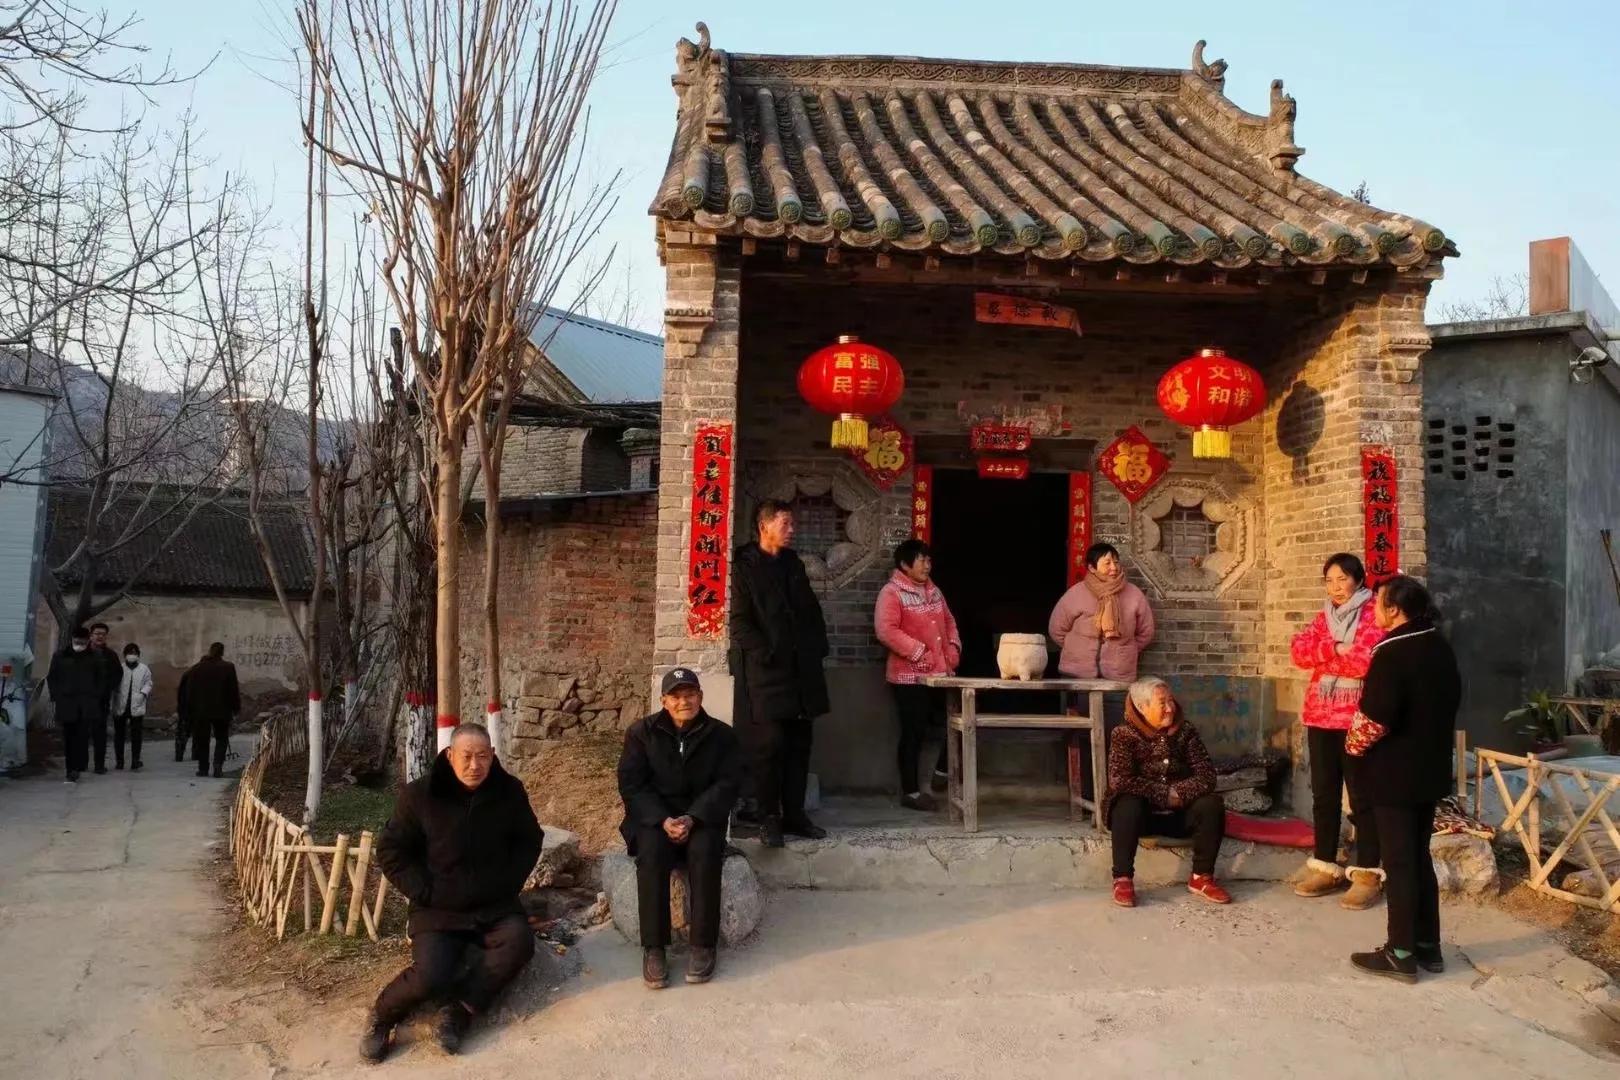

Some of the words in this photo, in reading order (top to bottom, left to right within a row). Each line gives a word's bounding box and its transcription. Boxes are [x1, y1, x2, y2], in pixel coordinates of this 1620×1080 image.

[833, 352, 880, 371] 富强
[1208, 364, 1252, 382] 文明
[832, 376, 880, 395] 民主
[1208, 385, 1253, 406] 和谐
[863, 428, 905, 471] 福
[1113, 441, 1153, 484] 福
